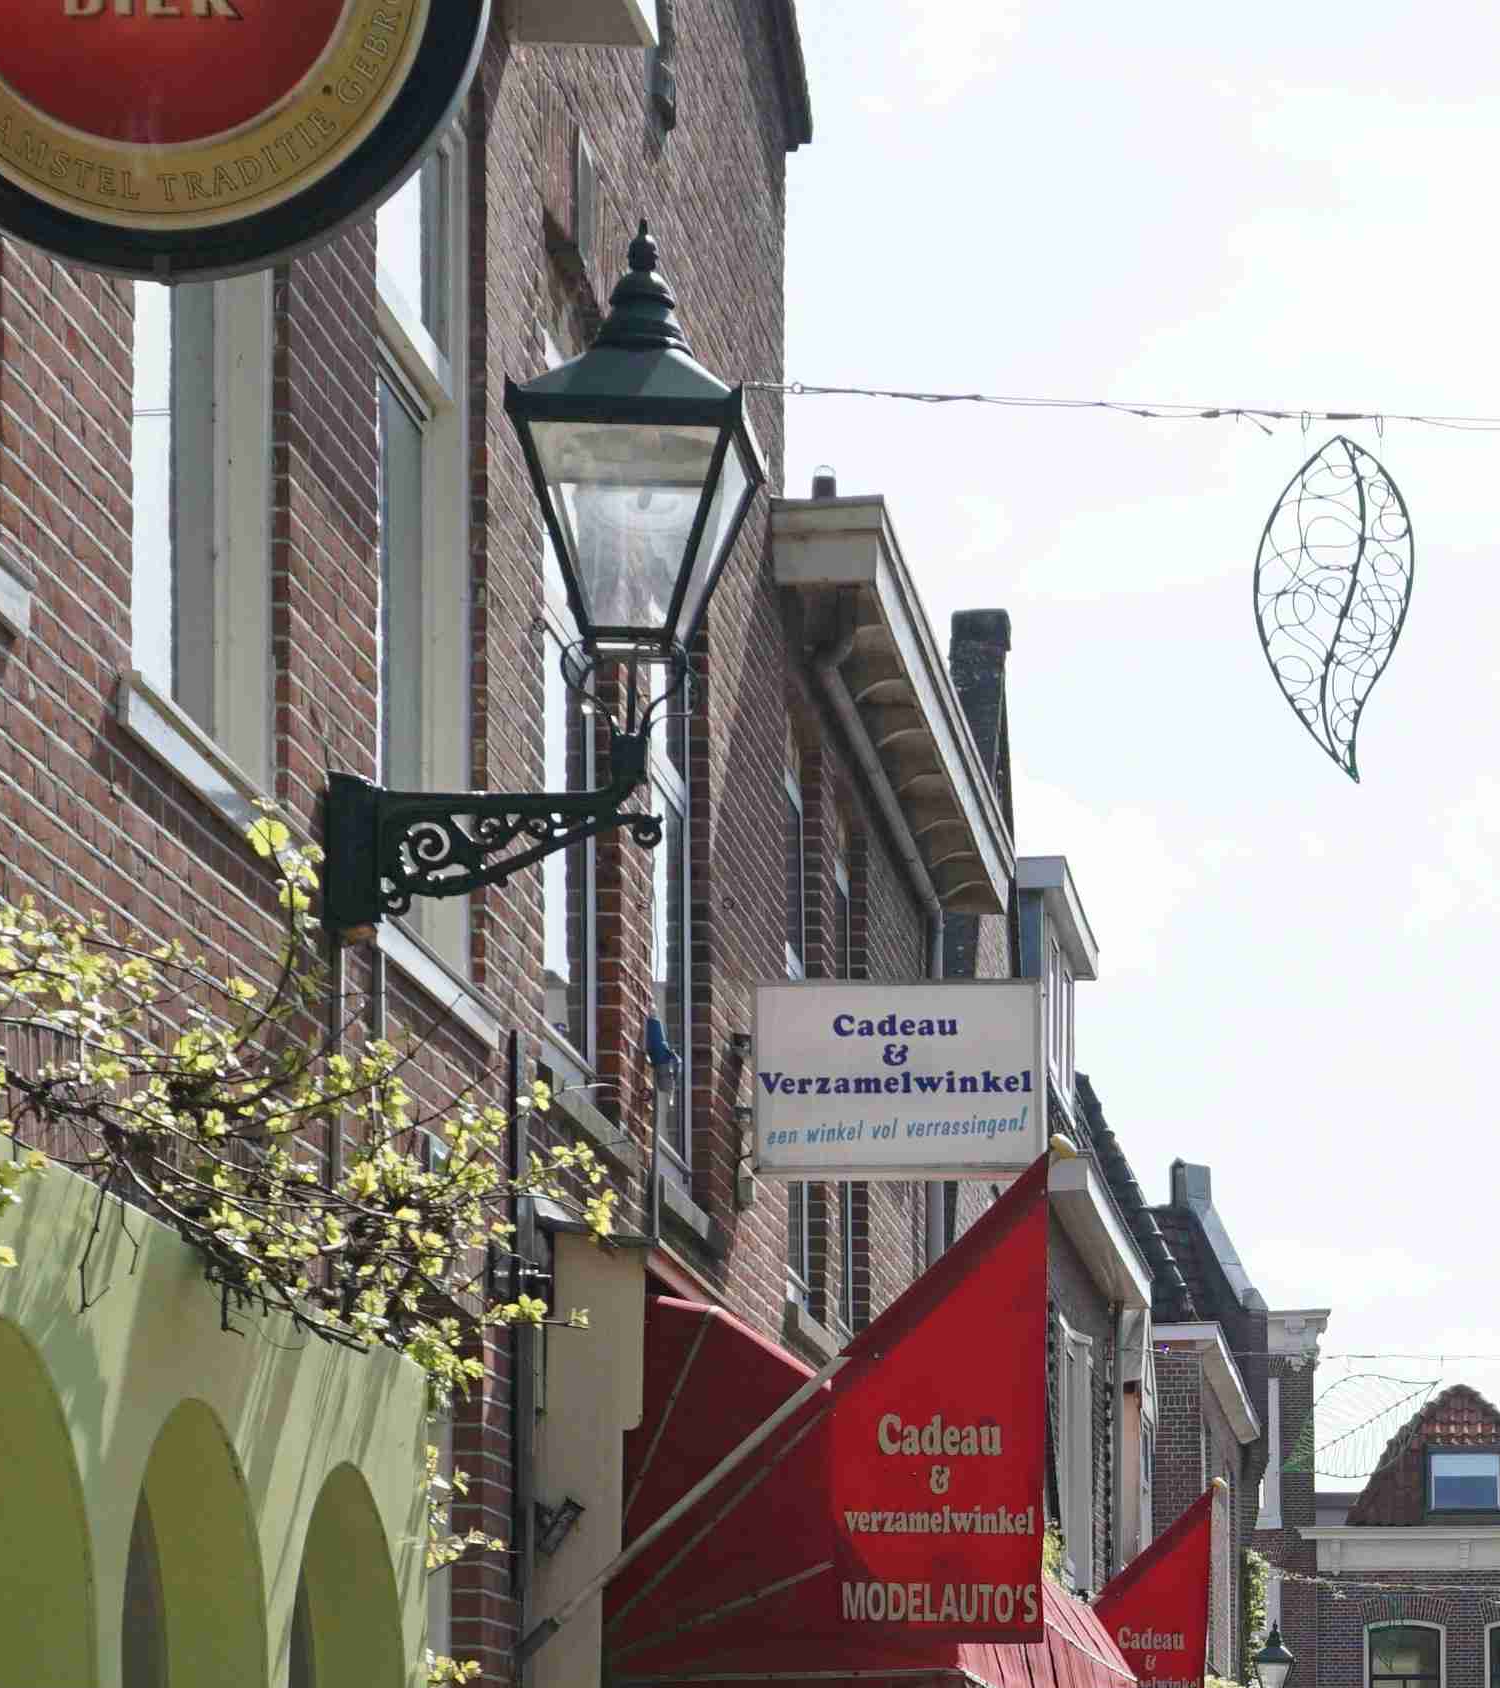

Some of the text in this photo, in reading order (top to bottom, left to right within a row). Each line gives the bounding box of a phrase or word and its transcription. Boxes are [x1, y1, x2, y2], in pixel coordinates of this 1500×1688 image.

[336, 0, 401, 104] GEBR
[156, 105, 338, 202] TRADITIE
[833, 1014, 958, 1037] Cadeau
[882, 1044, 909, 1066] &
[758, 1071, 1033, 1095] Verzamelwinkel
[766, 1105, 1028, 1146] een winkel vol verrassingen!
[878, 1413, 1003, 1456] Cadeau
[929, 1465, 950, 1494] &
[844, 1505, 1035, 1536] verzamelwinkel
[841, 1582, 1038, 1623] MODELAUTO'S
[1117, 1626, 1186, 1650] Cadeau
[1145, 1654, 1157, 1671] &
